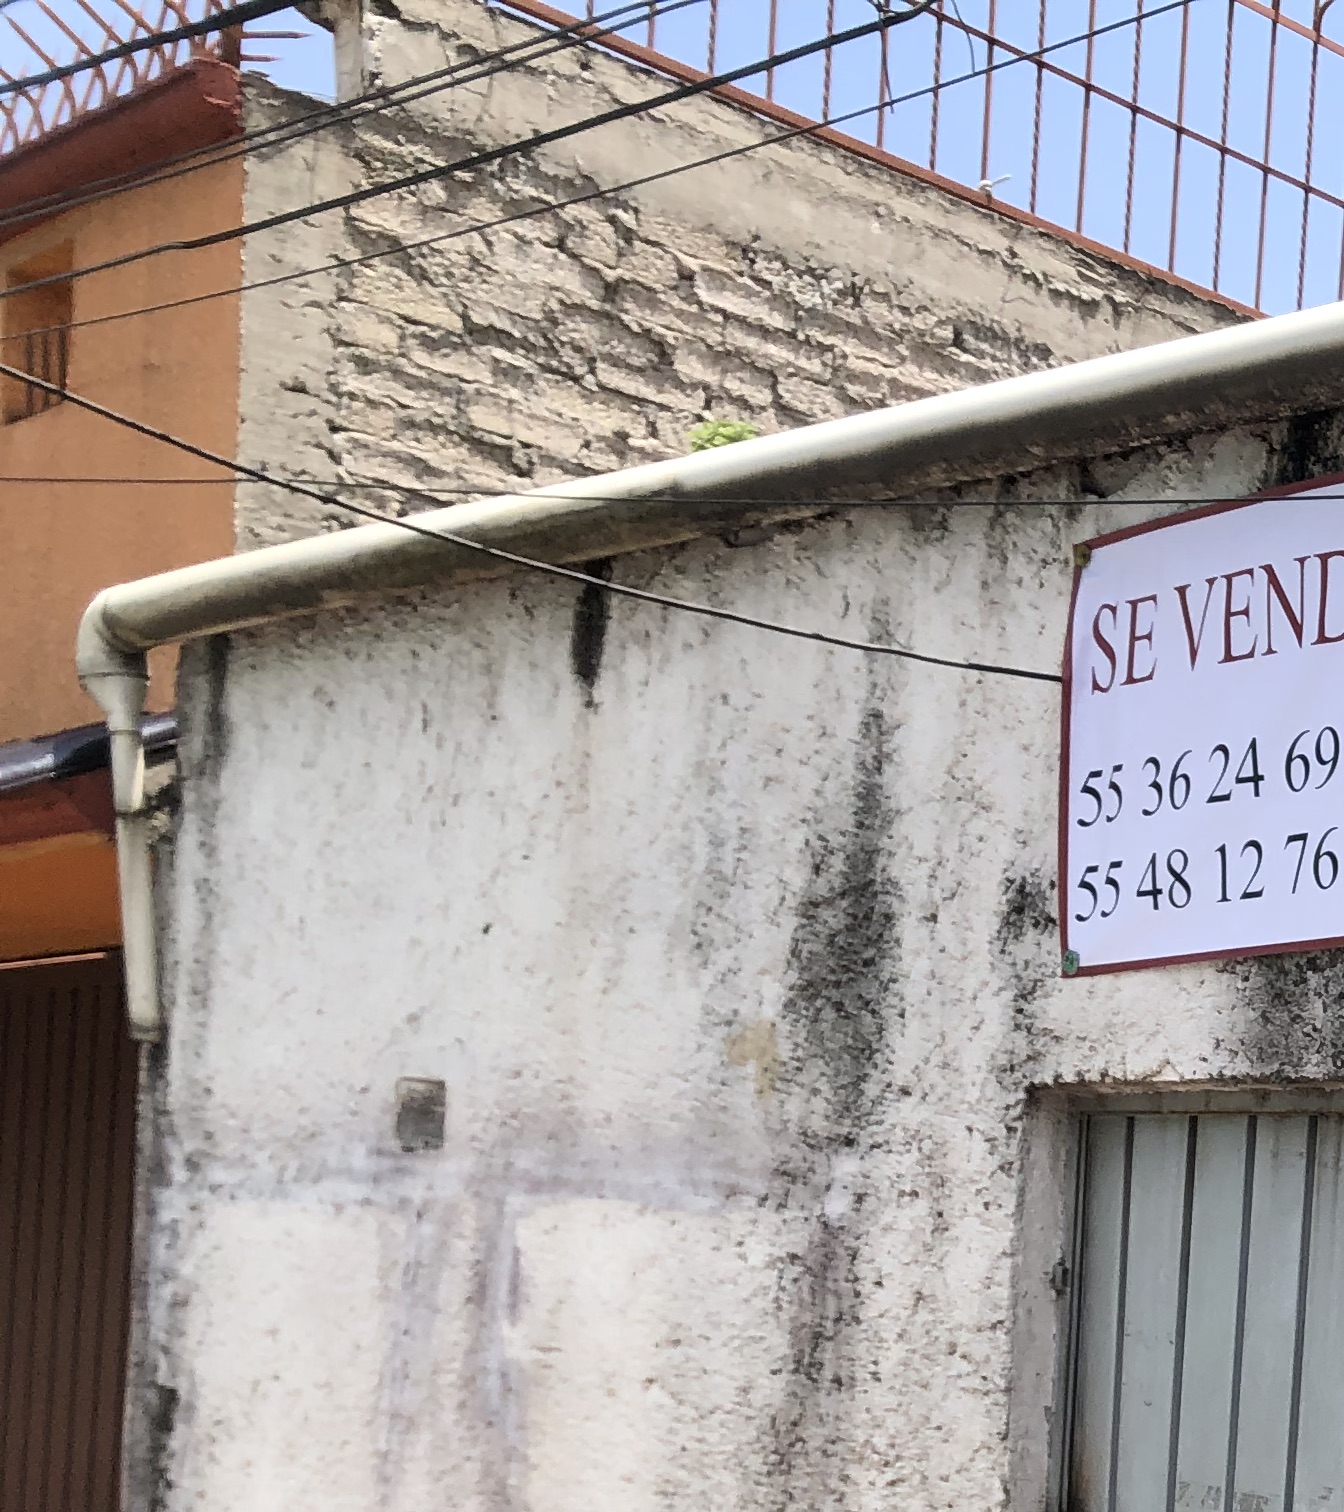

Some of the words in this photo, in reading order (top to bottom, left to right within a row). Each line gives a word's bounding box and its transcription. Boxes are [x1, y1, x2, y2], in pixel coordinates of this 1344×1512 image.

[1091, 594, 1158, 695] SE
[1077, 763, 1124, 827] 55
[1141, 749, 1192, 817] 36
[1206, 736, 1265, 804] 24
[1285, 726, 1340, 793] 69
[1074, 860, 1123, 922] 55
[1136, 848, 1192, 911] 48
[1214, 839, 1265, 903] 12
[1284, 826, 1339, 895] 76
